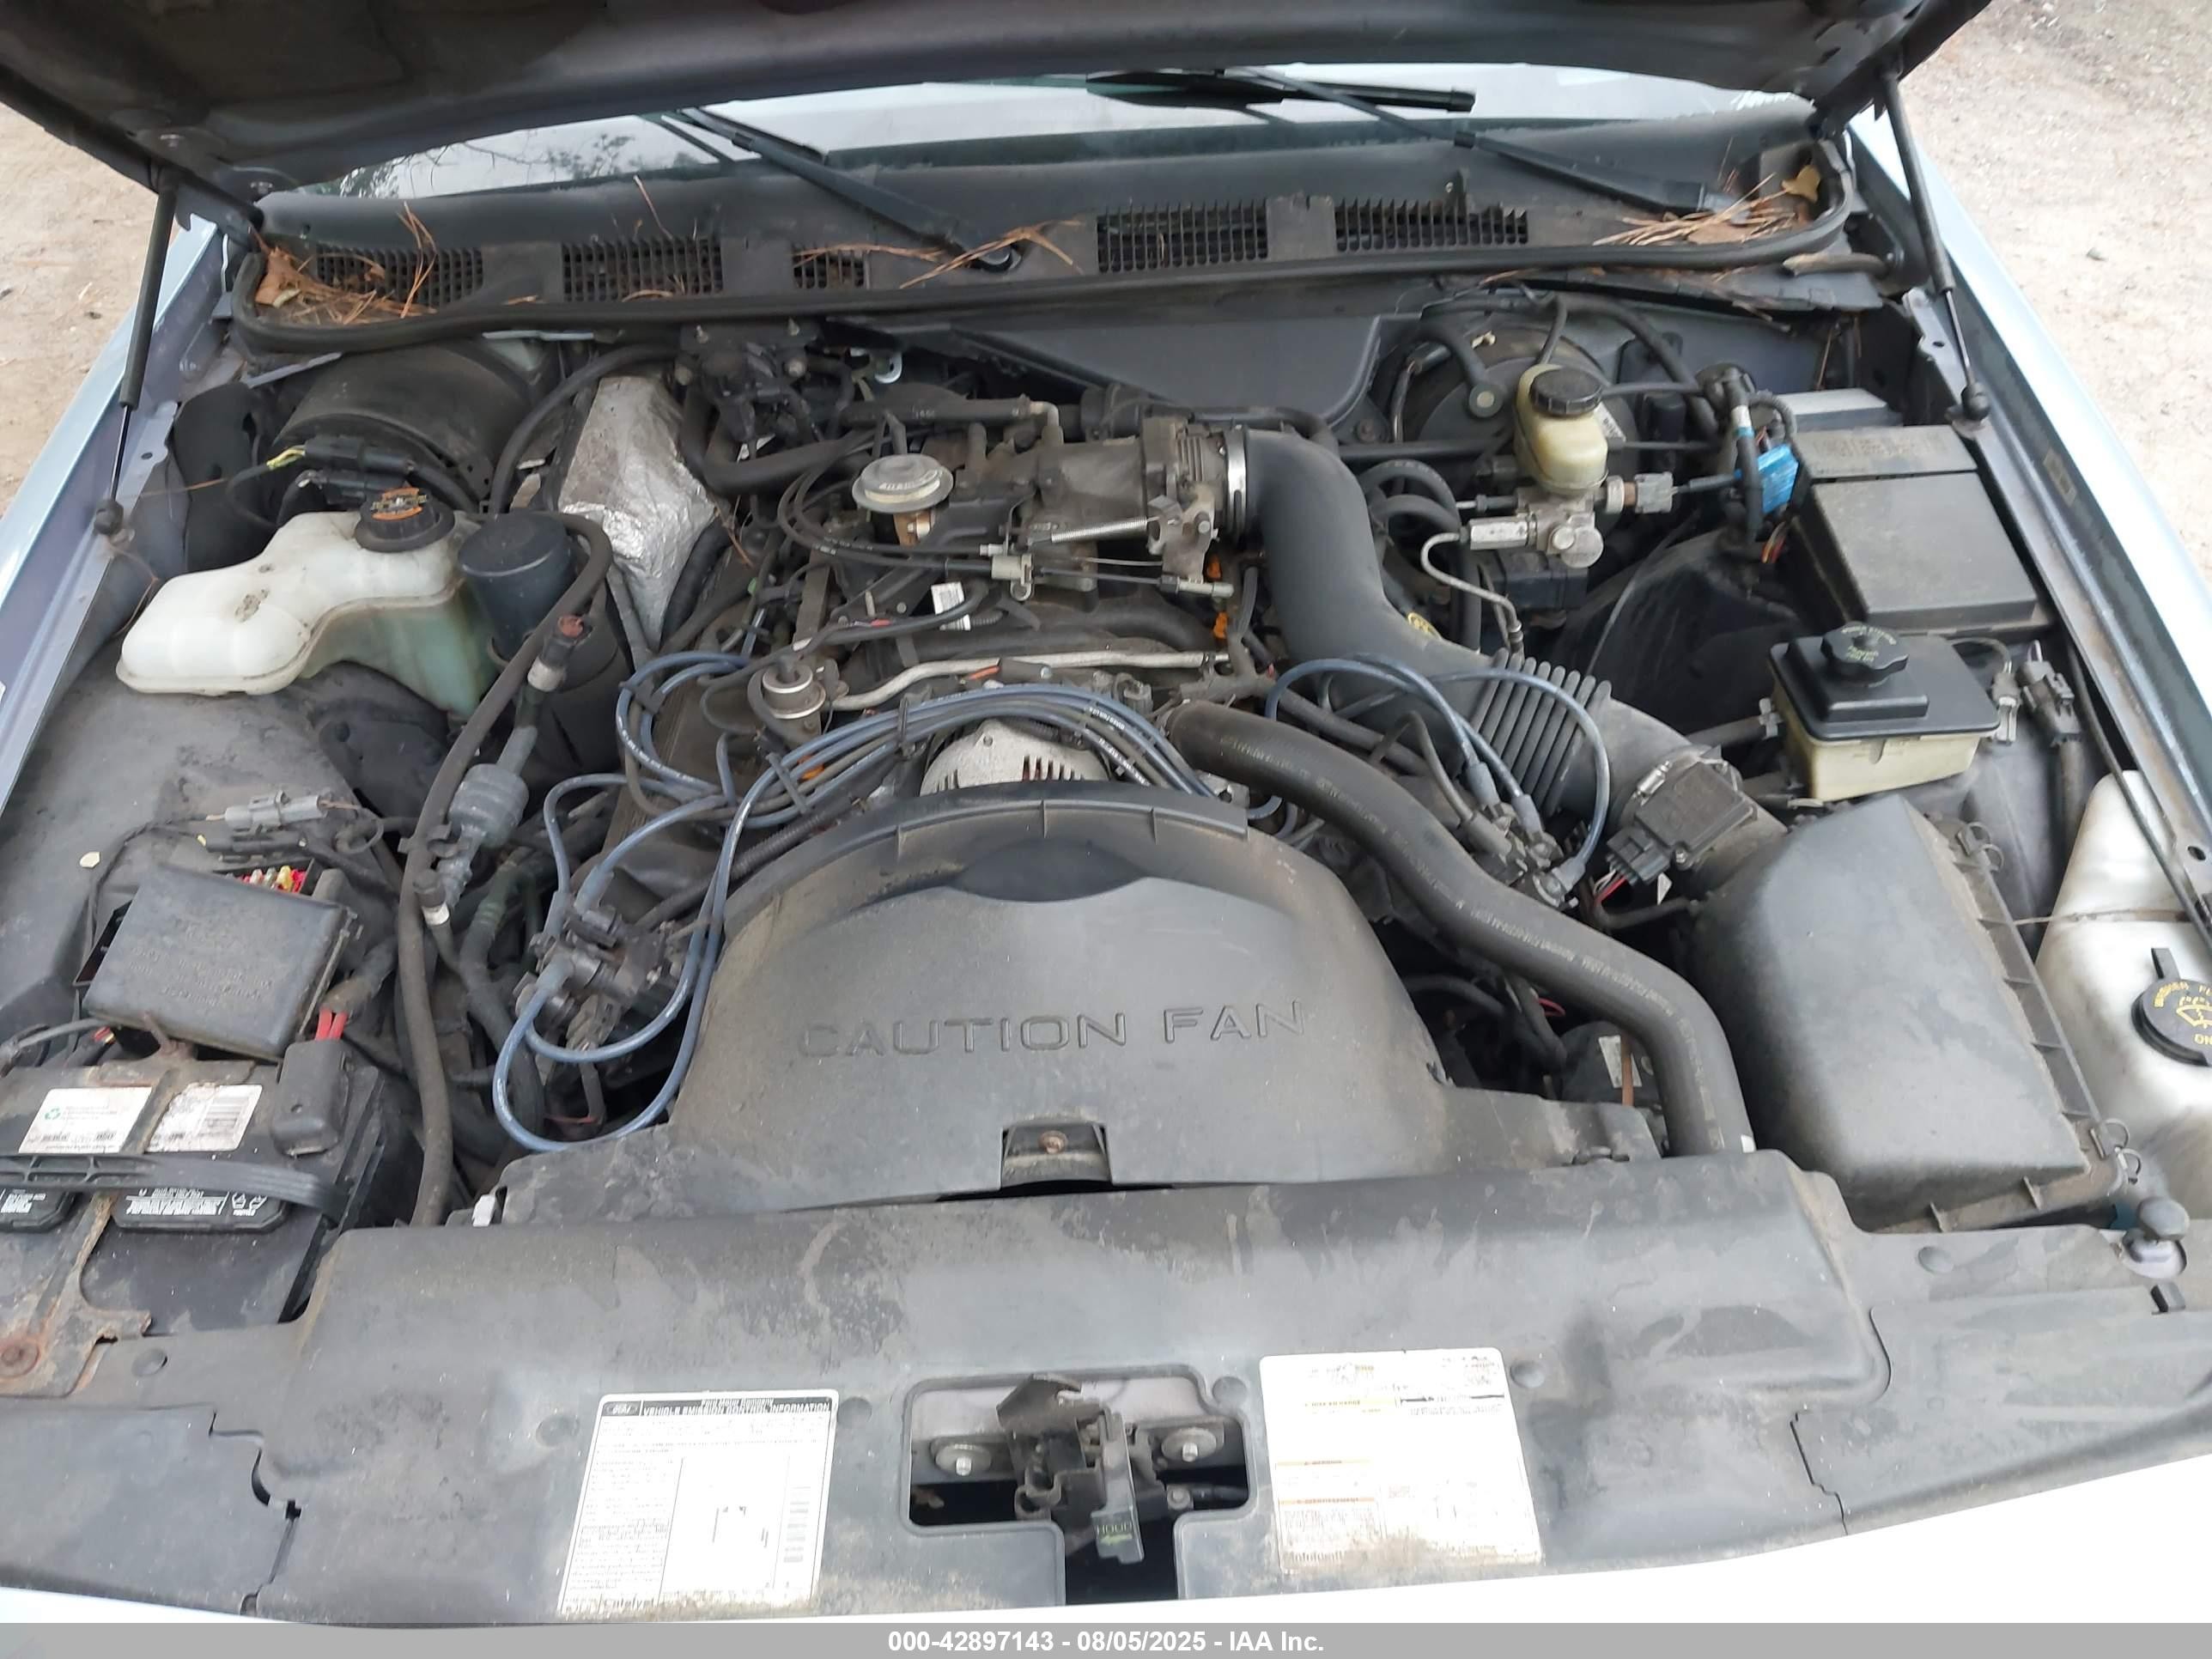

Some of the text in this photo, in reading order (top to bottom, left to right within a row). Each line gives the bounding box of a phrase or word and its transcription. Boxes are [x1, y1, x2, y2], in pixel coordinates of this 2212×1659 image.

[797, 998, 1305, 1059] CAUTION FAN
[770, 1401, 831, 1415] INFORMATION
